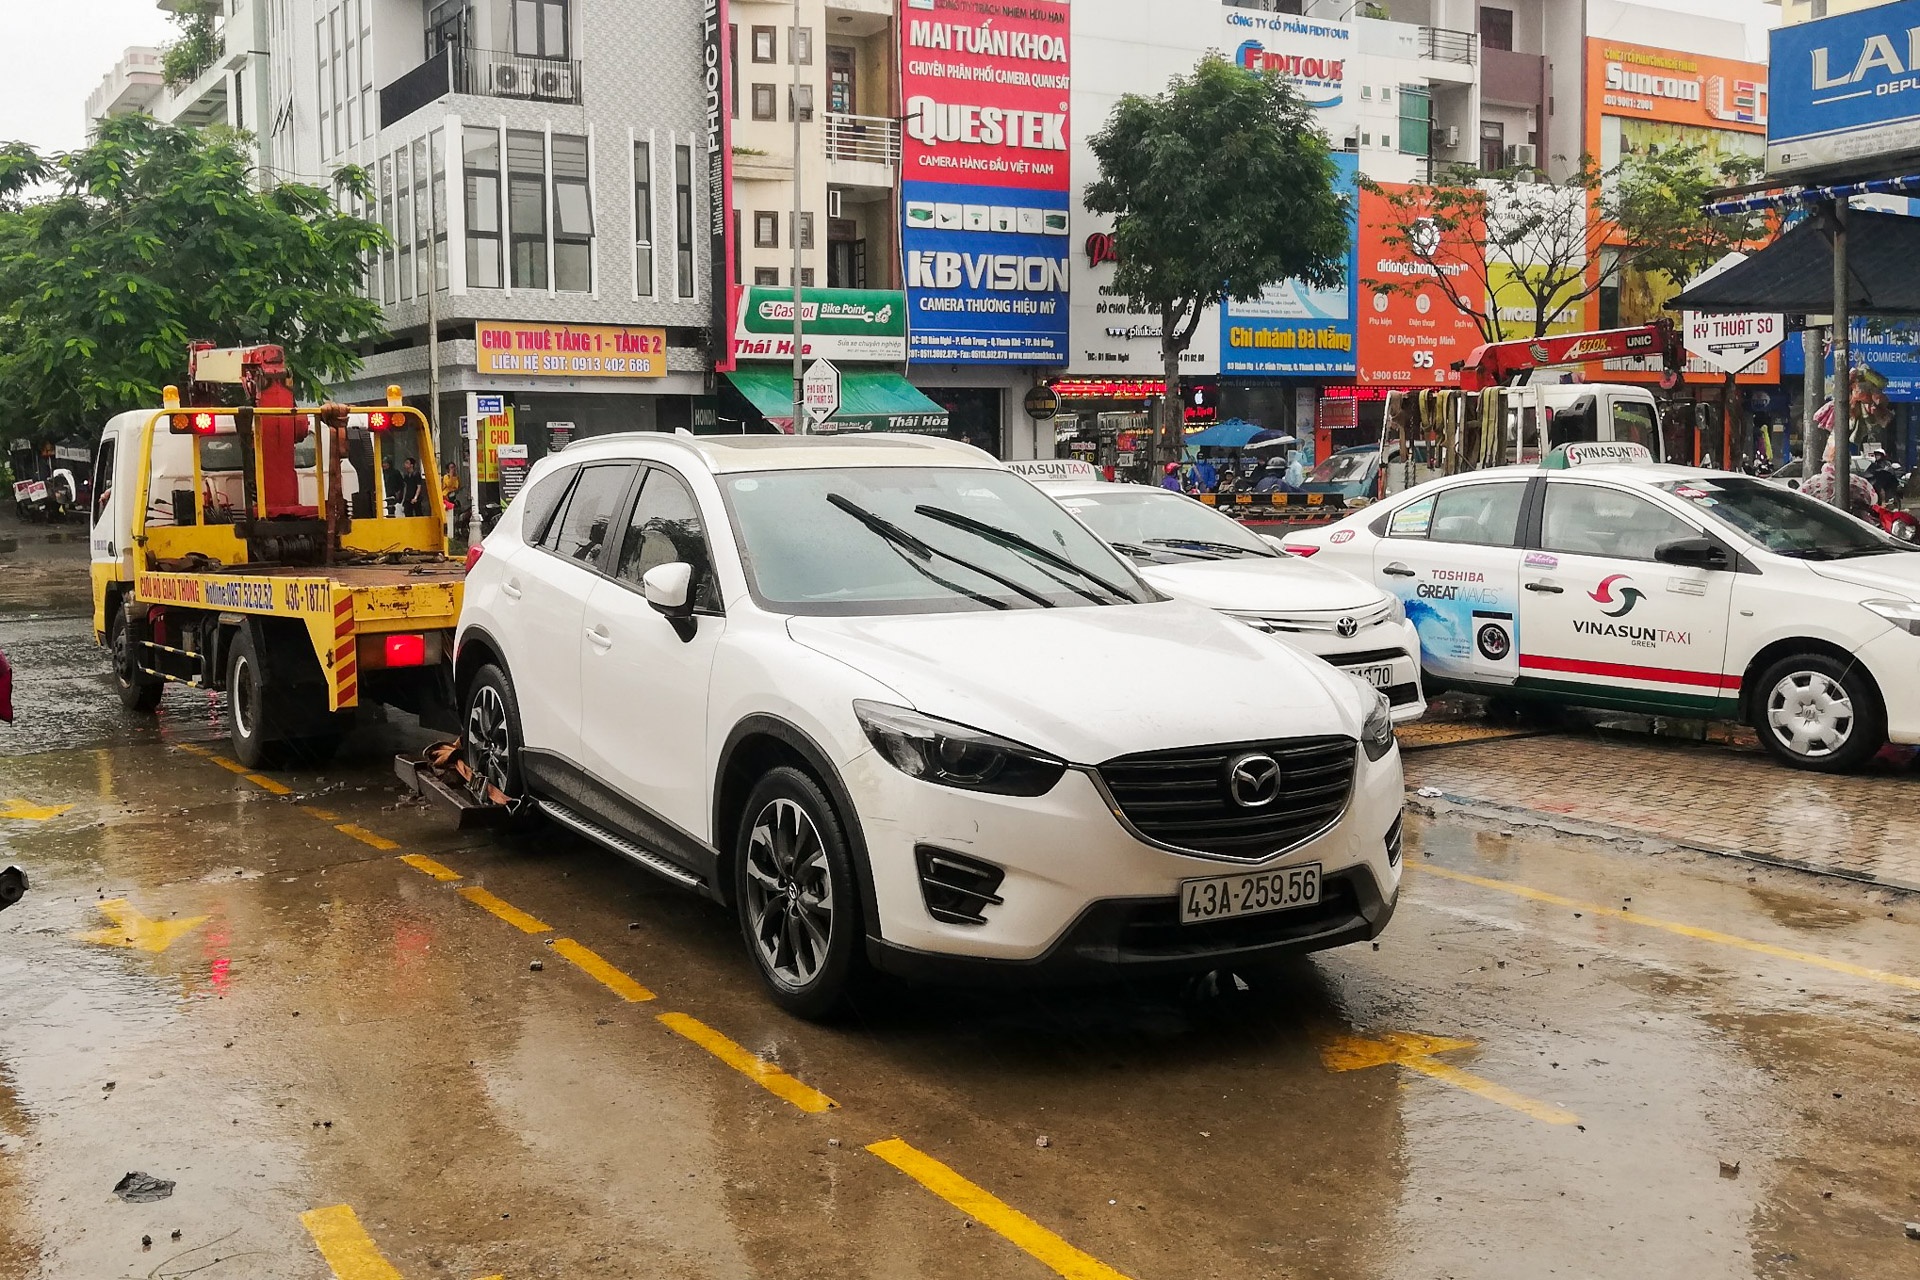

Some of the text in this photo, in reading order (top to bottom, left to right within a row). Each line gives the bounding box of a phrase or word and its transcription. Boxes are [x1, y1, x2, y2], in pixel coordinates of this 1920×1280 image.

[1226, 12, 1349, 40] CÔNG TY CỔ PHẦN FIDITOUR
[910, 19, 1068, 63] MAI TUẤN KHOA
[1244, 47, 1344, 82] FIDITOUR
[909, 61, 1070, 90] CHUYÊN PHÂN PHỐI CAMERA QUAN SÁT
[1605, 62, 1700, 102] Suncom
[705, 43, 720, 154] PHUOC
[906, 95, 1068, 151] QUESTEK
[918, 155, 1054, 175] CAMERA HÀNG ĐẦU VIỆT NAM
[907, 250, 1069, 293] KBVISION
[821, 303, 841, 314] Bike
[842, 304, 866, 315] Point
[920, 298, 1057, 316] CAMERA THƯƠNG HIỆU MỸ
[1369, 317, 1393, 326] Phụ kiện
[1409, 318, 1422, 326] Điện
[1454, 320, 1465, 328] Dịch
[1693, 321, 1709, 339] KỸ
[1715, 319, 1753, 338] THUẬT
[482, 330, 512, 350] CHO
[515, 329, 552, 350] THUÊ
[554, 327, 590, 351] TẦNG
[594, 334, 602, 352] 1
[614, 328, 649, 353] TẦNG
[652, 336, 662, 354] 2
[734, 339, 812, 355] Thái Ha
[858, 340, 881, 349] chuyên
[882, 340, 902, 348] nghiệp
[1230, 326, 1351, 351] Chi nhánh Đà Nẵng
[1388, 335, 1456, 347] Di Động Thông Minh
[1627, 335, 1652, 347] UNIC
[492, 352, 650, 373] LIÊN HỆ SĐT: 0913 402 686
[1412, 351, 1434, 369] 95
[1372, 370, 1411, 380] 1900 6122
[888, 415, 949, 427] Thái Hòa
[490, 430, 509, 444] CHO
[1008, 463, 1091, 475] INASUNTAXI
[1432, 569, 1484, 583] TOSHIBA
[162, 579, 177, 600] GIAO
[177, 577, 200, 603] THÔNG
[1631, 639, 1656, 648] GREEN
[1187, 870, 1316, 917] 43A-259.56
